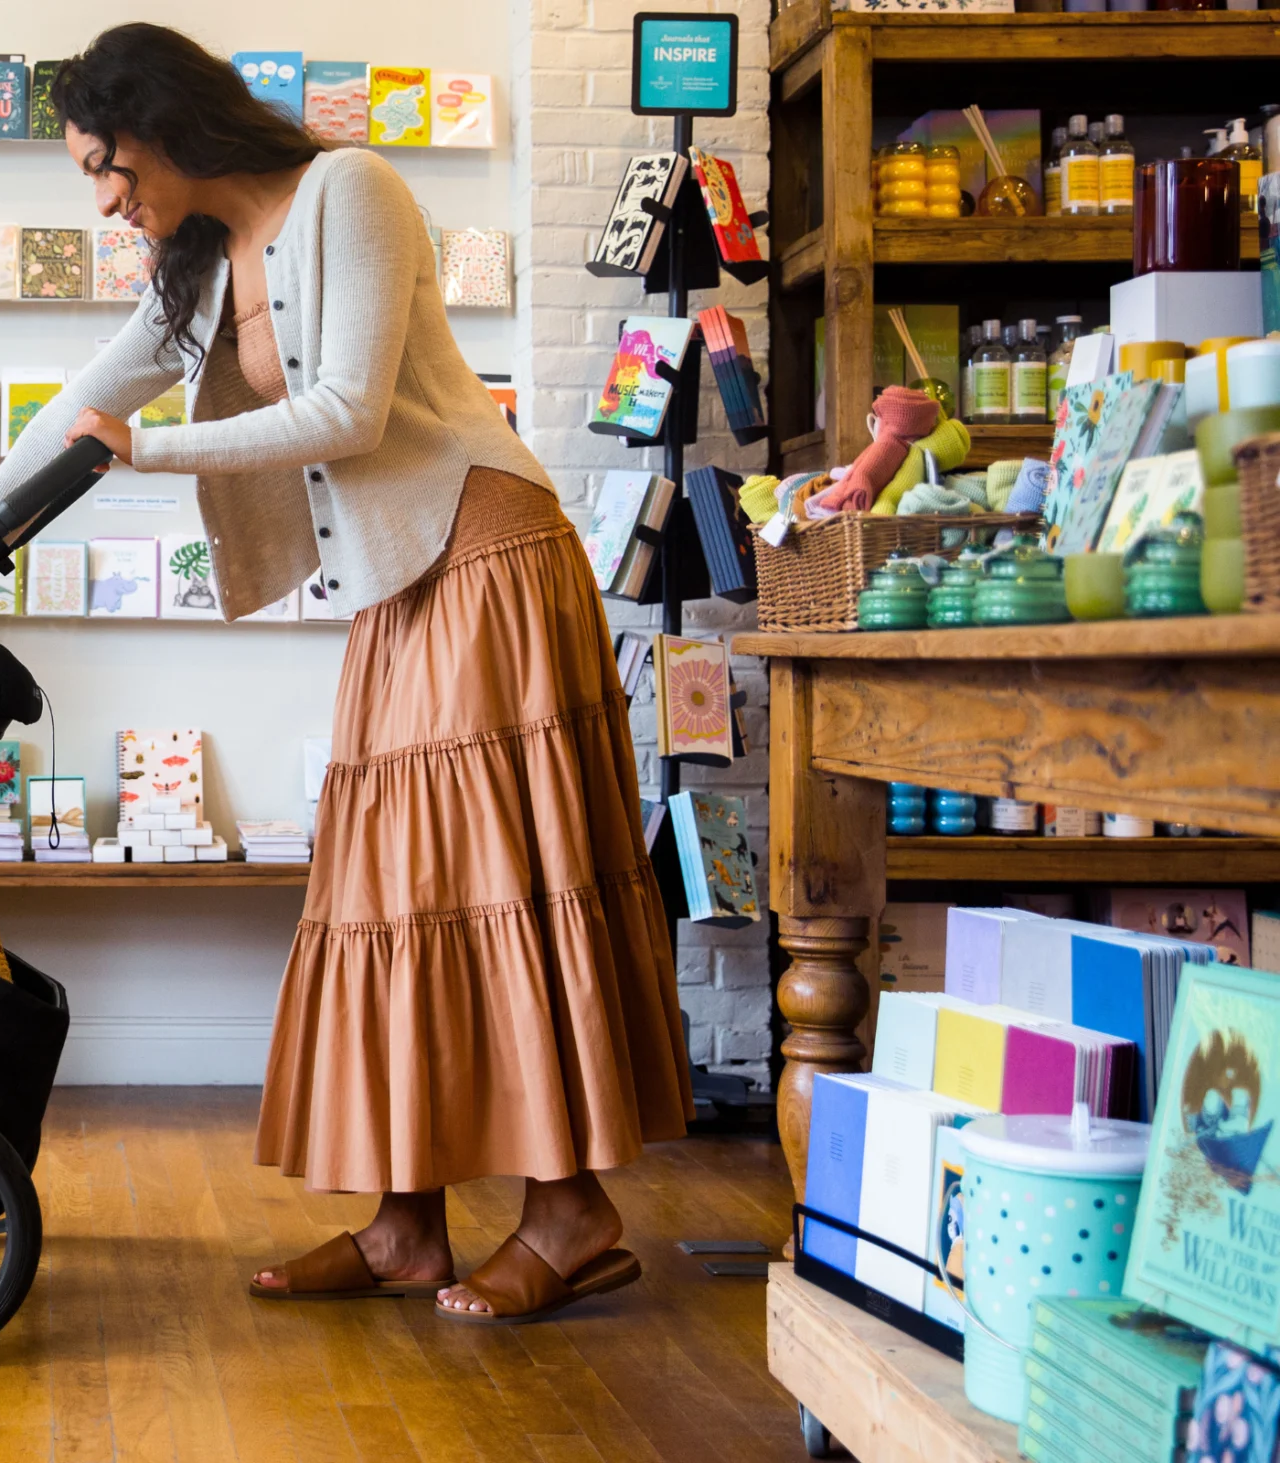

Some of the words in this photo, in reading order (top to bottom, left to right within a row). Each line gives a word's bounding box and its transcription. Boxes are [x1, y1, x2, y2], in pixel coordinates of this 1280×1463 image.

[654, 47, 717, 62] INSPIRE
[608, 380, 639, 397] MUSIC
[1228, 1198, 1280, 1258] WIN
[1183, 1231, 1277, 1306] WILLOWS
